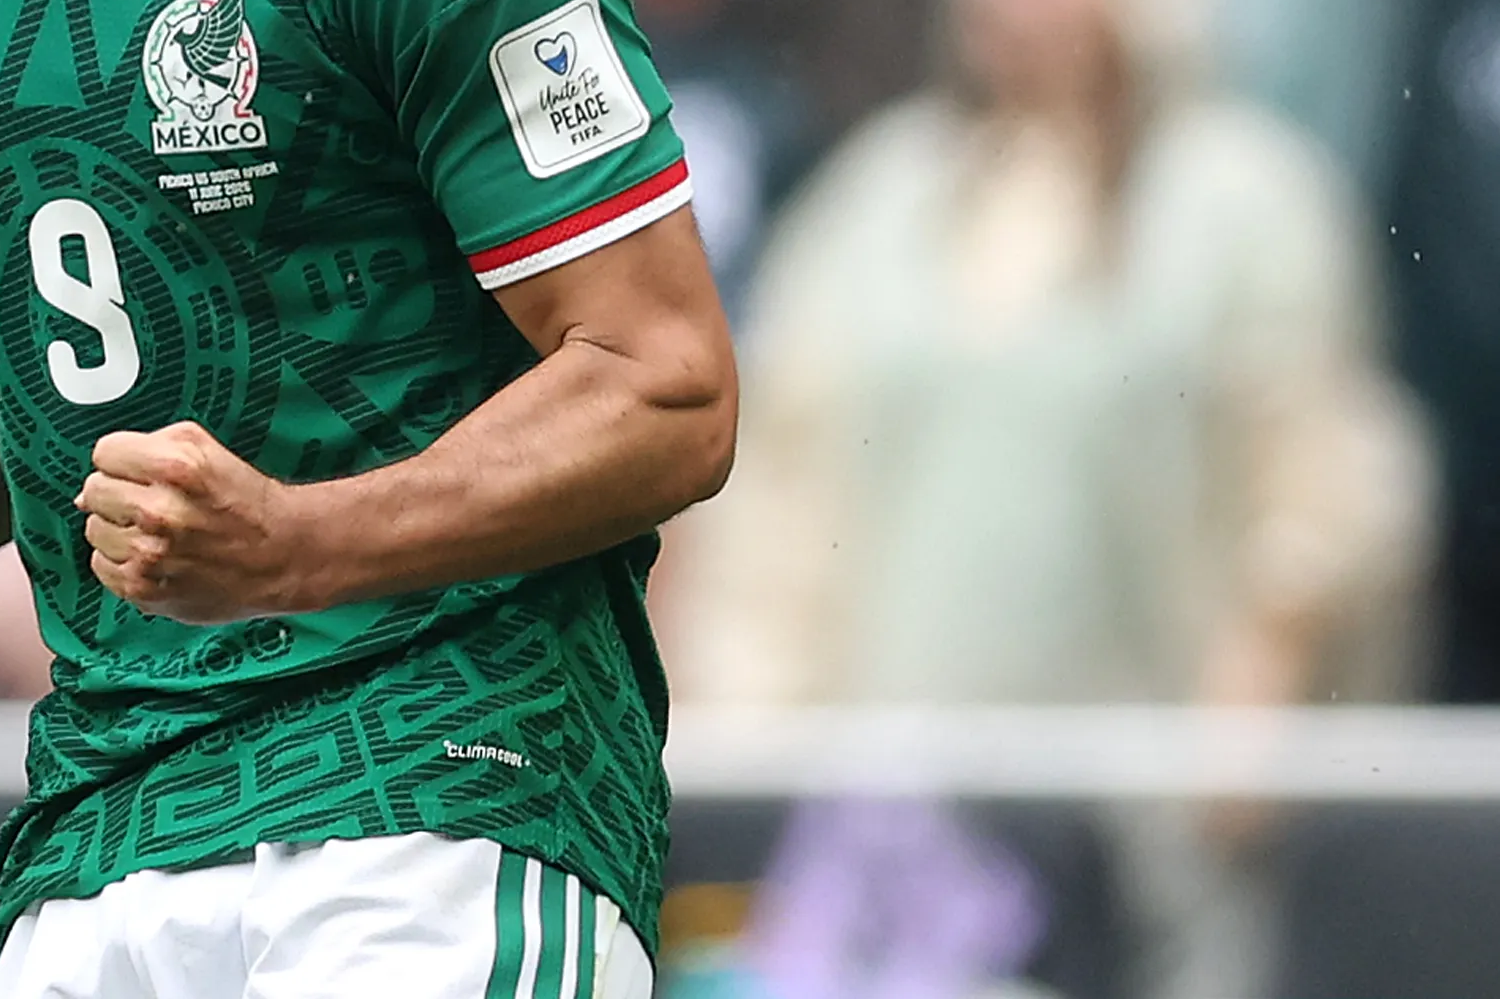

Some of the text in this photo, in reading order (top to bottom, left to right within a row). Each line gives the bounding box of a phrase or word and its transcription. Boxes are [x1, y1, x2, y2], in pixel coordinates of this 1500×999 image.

[550, 92, 610, 135] PEACE
[156, 121, 262, 149] MÉXICO
[570, 125, 603, 145] FIFA
[29, 198, 140, 405] 9
